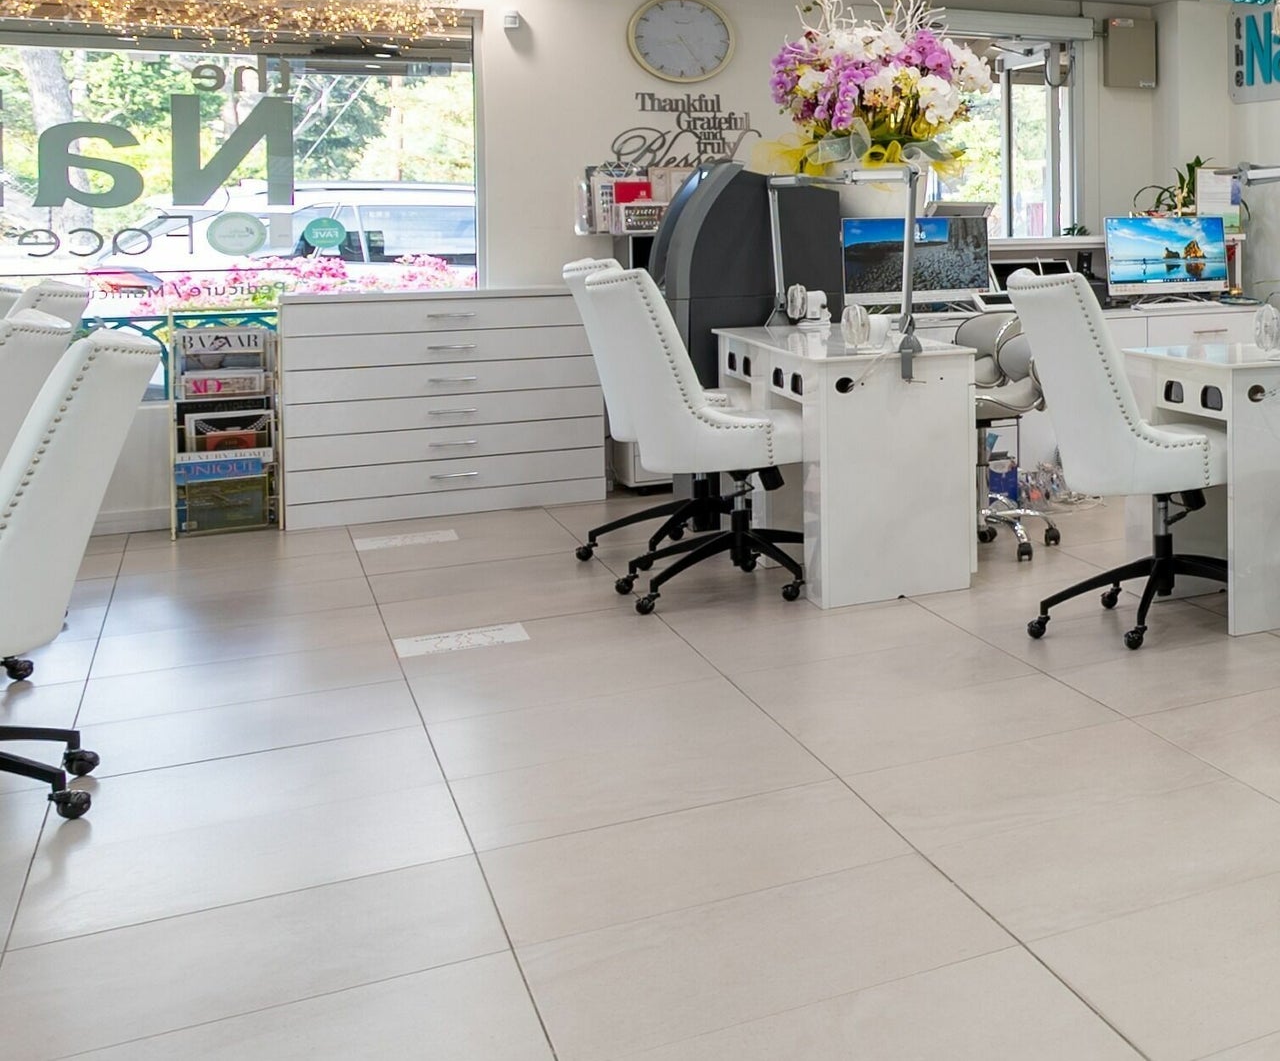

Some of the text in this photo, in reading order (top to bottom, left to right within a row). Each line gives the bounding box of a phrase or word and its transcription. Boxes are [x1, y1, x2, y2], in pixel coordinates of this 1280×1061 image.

[1234, 17, 1244, 87] the
[635, 92, 722, 113] Thankful
[676, 111, 750, 131] Grateful
[699, 129, 723, 141] and
[696, 138, 739, 156] truly
